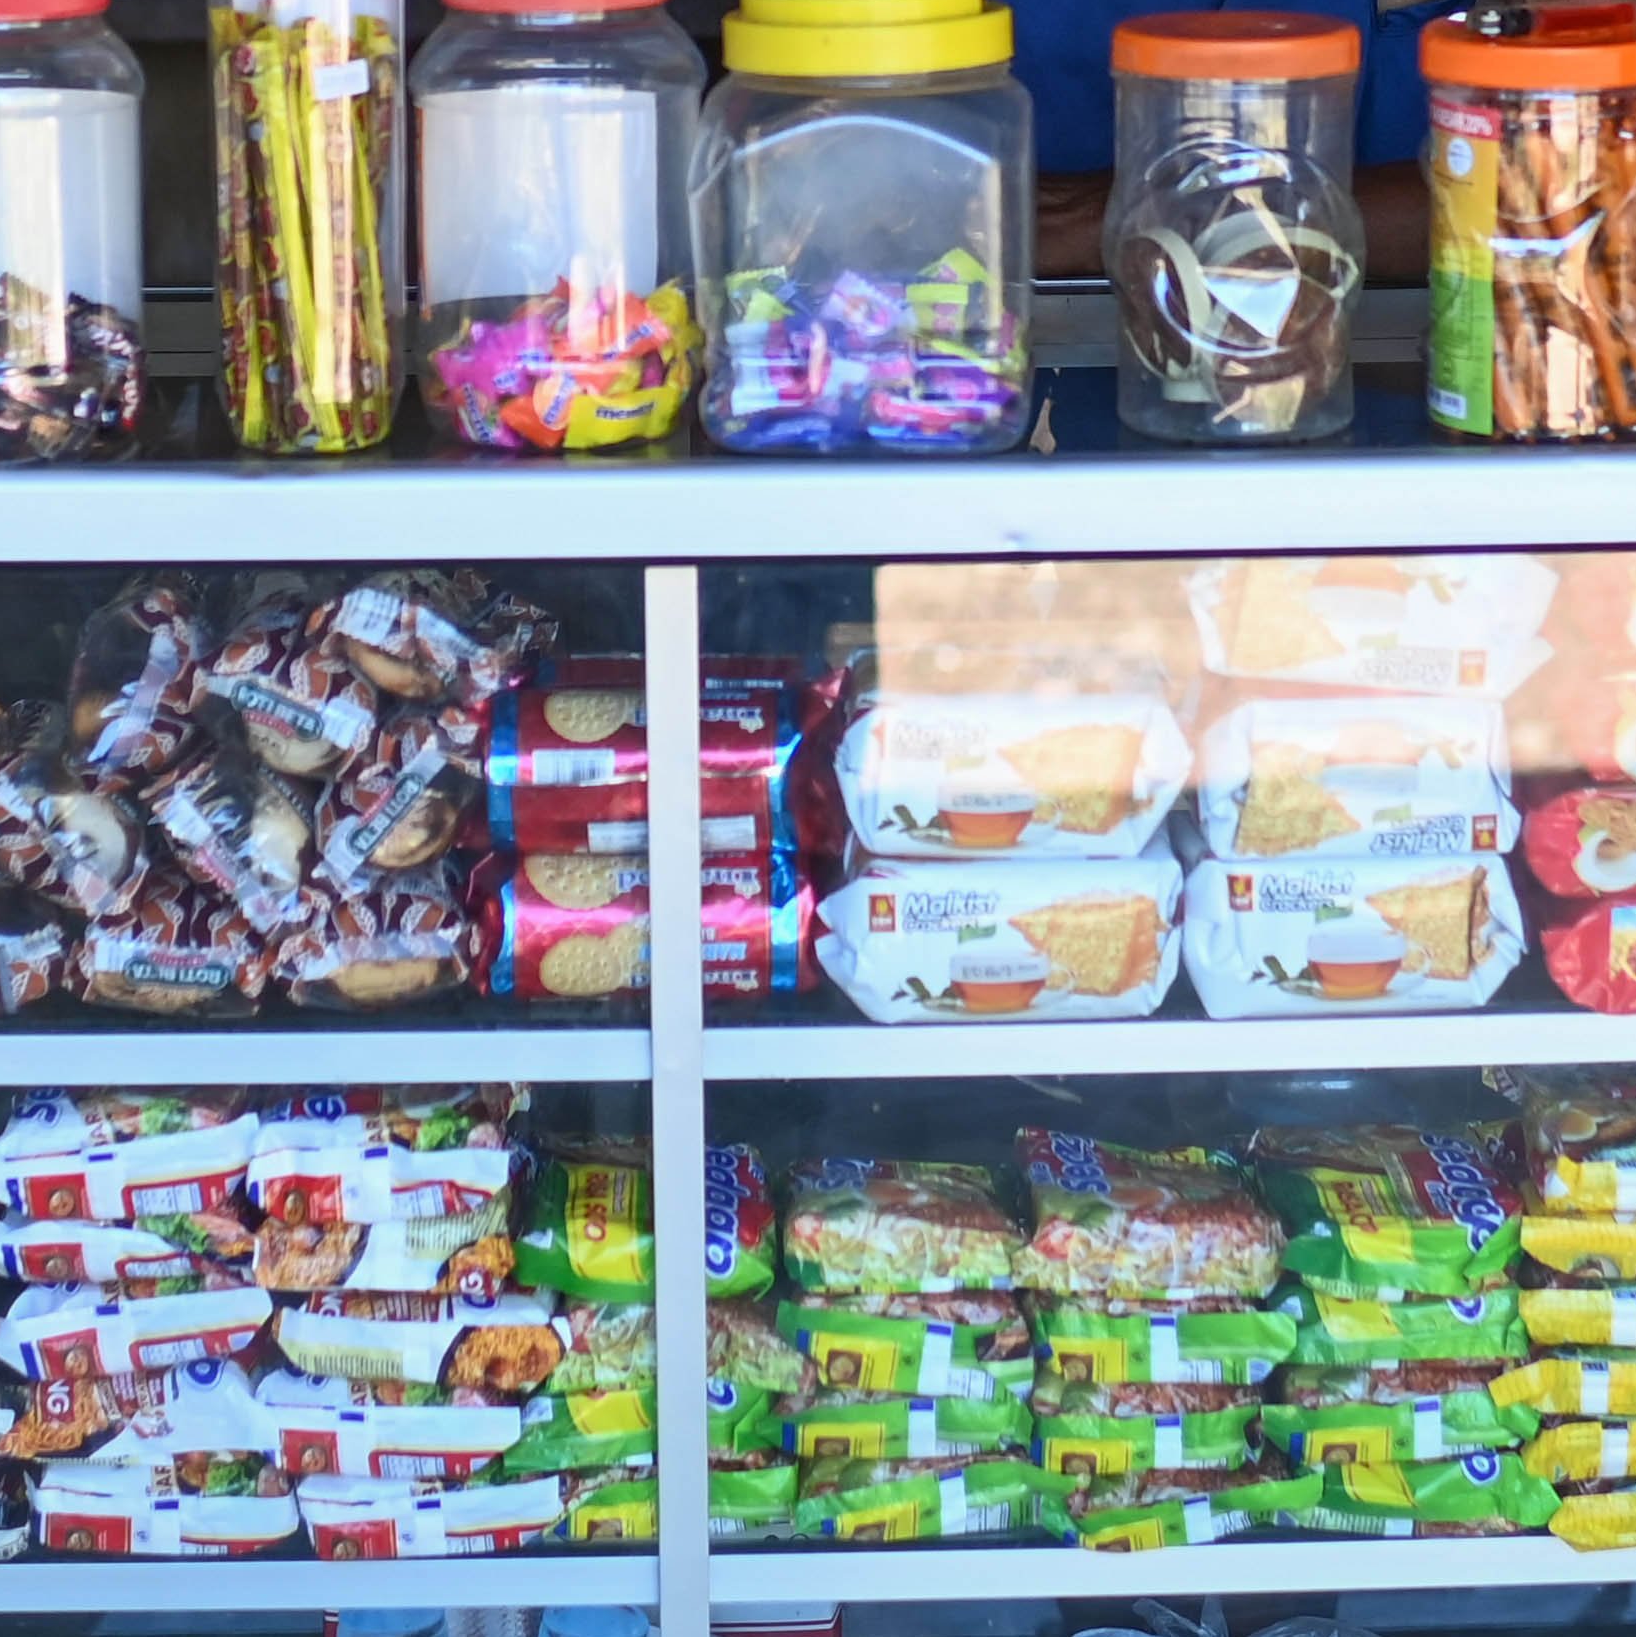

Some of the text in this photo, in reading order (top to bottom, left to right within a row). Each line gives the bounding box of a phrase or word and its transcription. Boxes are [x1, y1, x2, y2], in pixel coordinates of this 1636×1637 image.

[238, 686, 275, 714] ROTI
[383, 779, 421, 815] ROTI
[1369, 832, 1465, 855] Malkist
[1259, 871, 1355, 899] Malkist
[902, 890, 1001, 917] Malkist
[179, 968, 222, 984] ROTI
